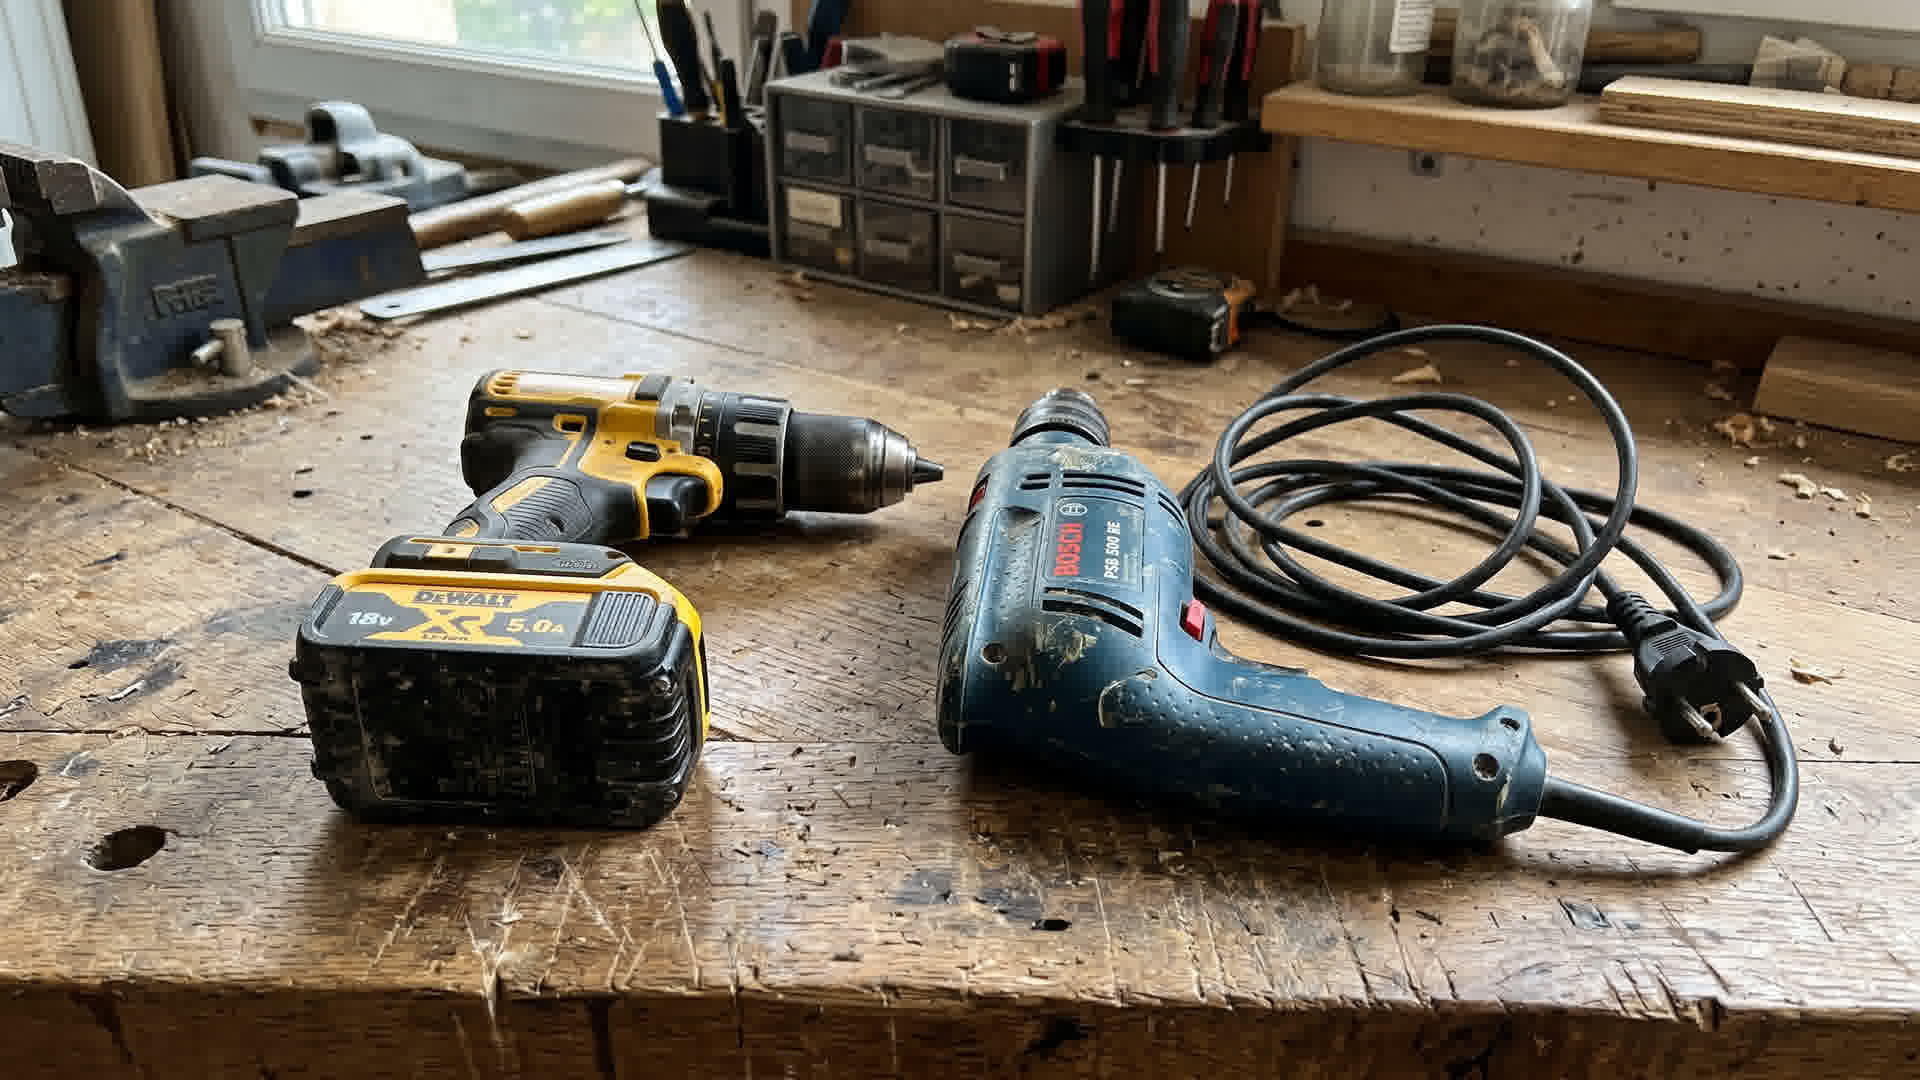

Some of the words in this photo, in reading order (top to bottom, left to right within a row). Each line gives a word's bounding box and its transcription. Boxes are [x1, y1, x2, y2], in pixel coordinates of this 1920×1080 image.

[1054, 523, 1083, 577] BOSCH
[1104, 535, 1120, 557] 500
[1103, 558, 1120, 579] PSB
[415, 608, 494, 635] XR
